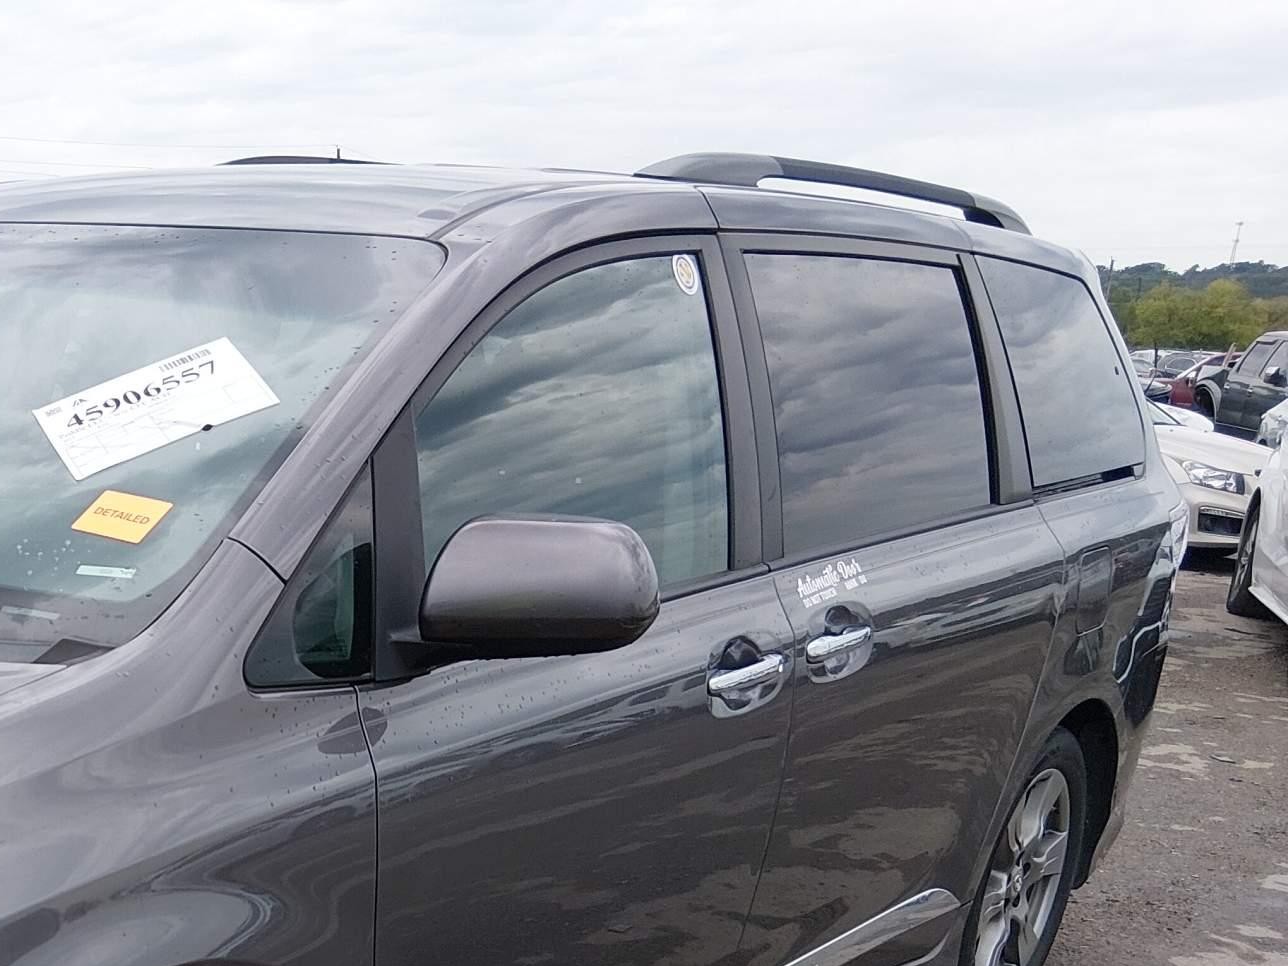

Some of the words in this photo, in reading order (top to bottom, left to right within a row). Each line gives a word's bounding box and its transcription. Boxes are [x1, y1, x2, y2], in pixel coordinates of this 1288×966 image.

[67, 360, 214, 428] 45906557
[93, 506, 150, 525] DETAILED
[797, 564, 840, 598] Automatic
